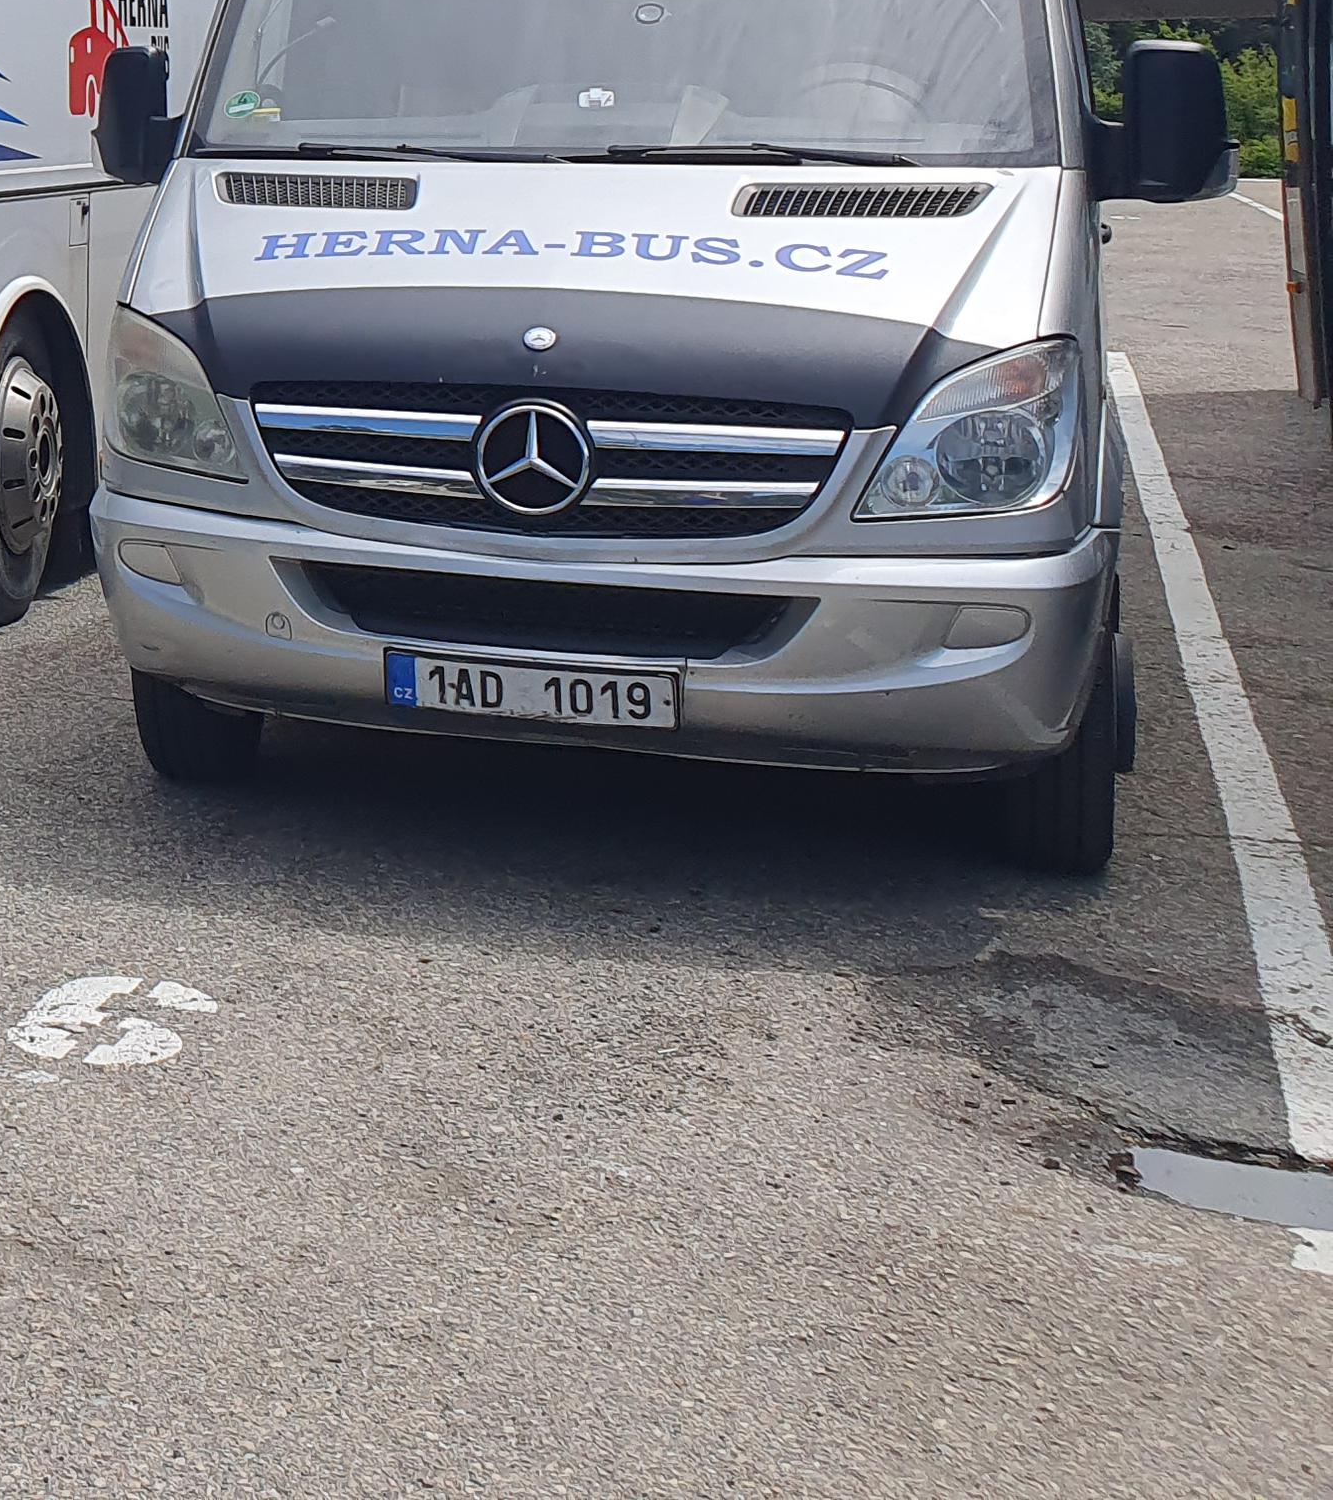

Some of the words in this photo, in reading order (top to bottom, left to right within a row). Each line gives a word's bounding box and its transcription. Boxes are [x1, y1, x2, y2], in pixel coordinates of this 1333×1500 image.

[253, 228, 890, 281] HERNA-BUS.CZ
[393, 685, 414, 701] CZ
[428, 665, 504, 709] 1AD
[543, 676, 652, 720] 1019
[7, 975, 219, 1065] 6
